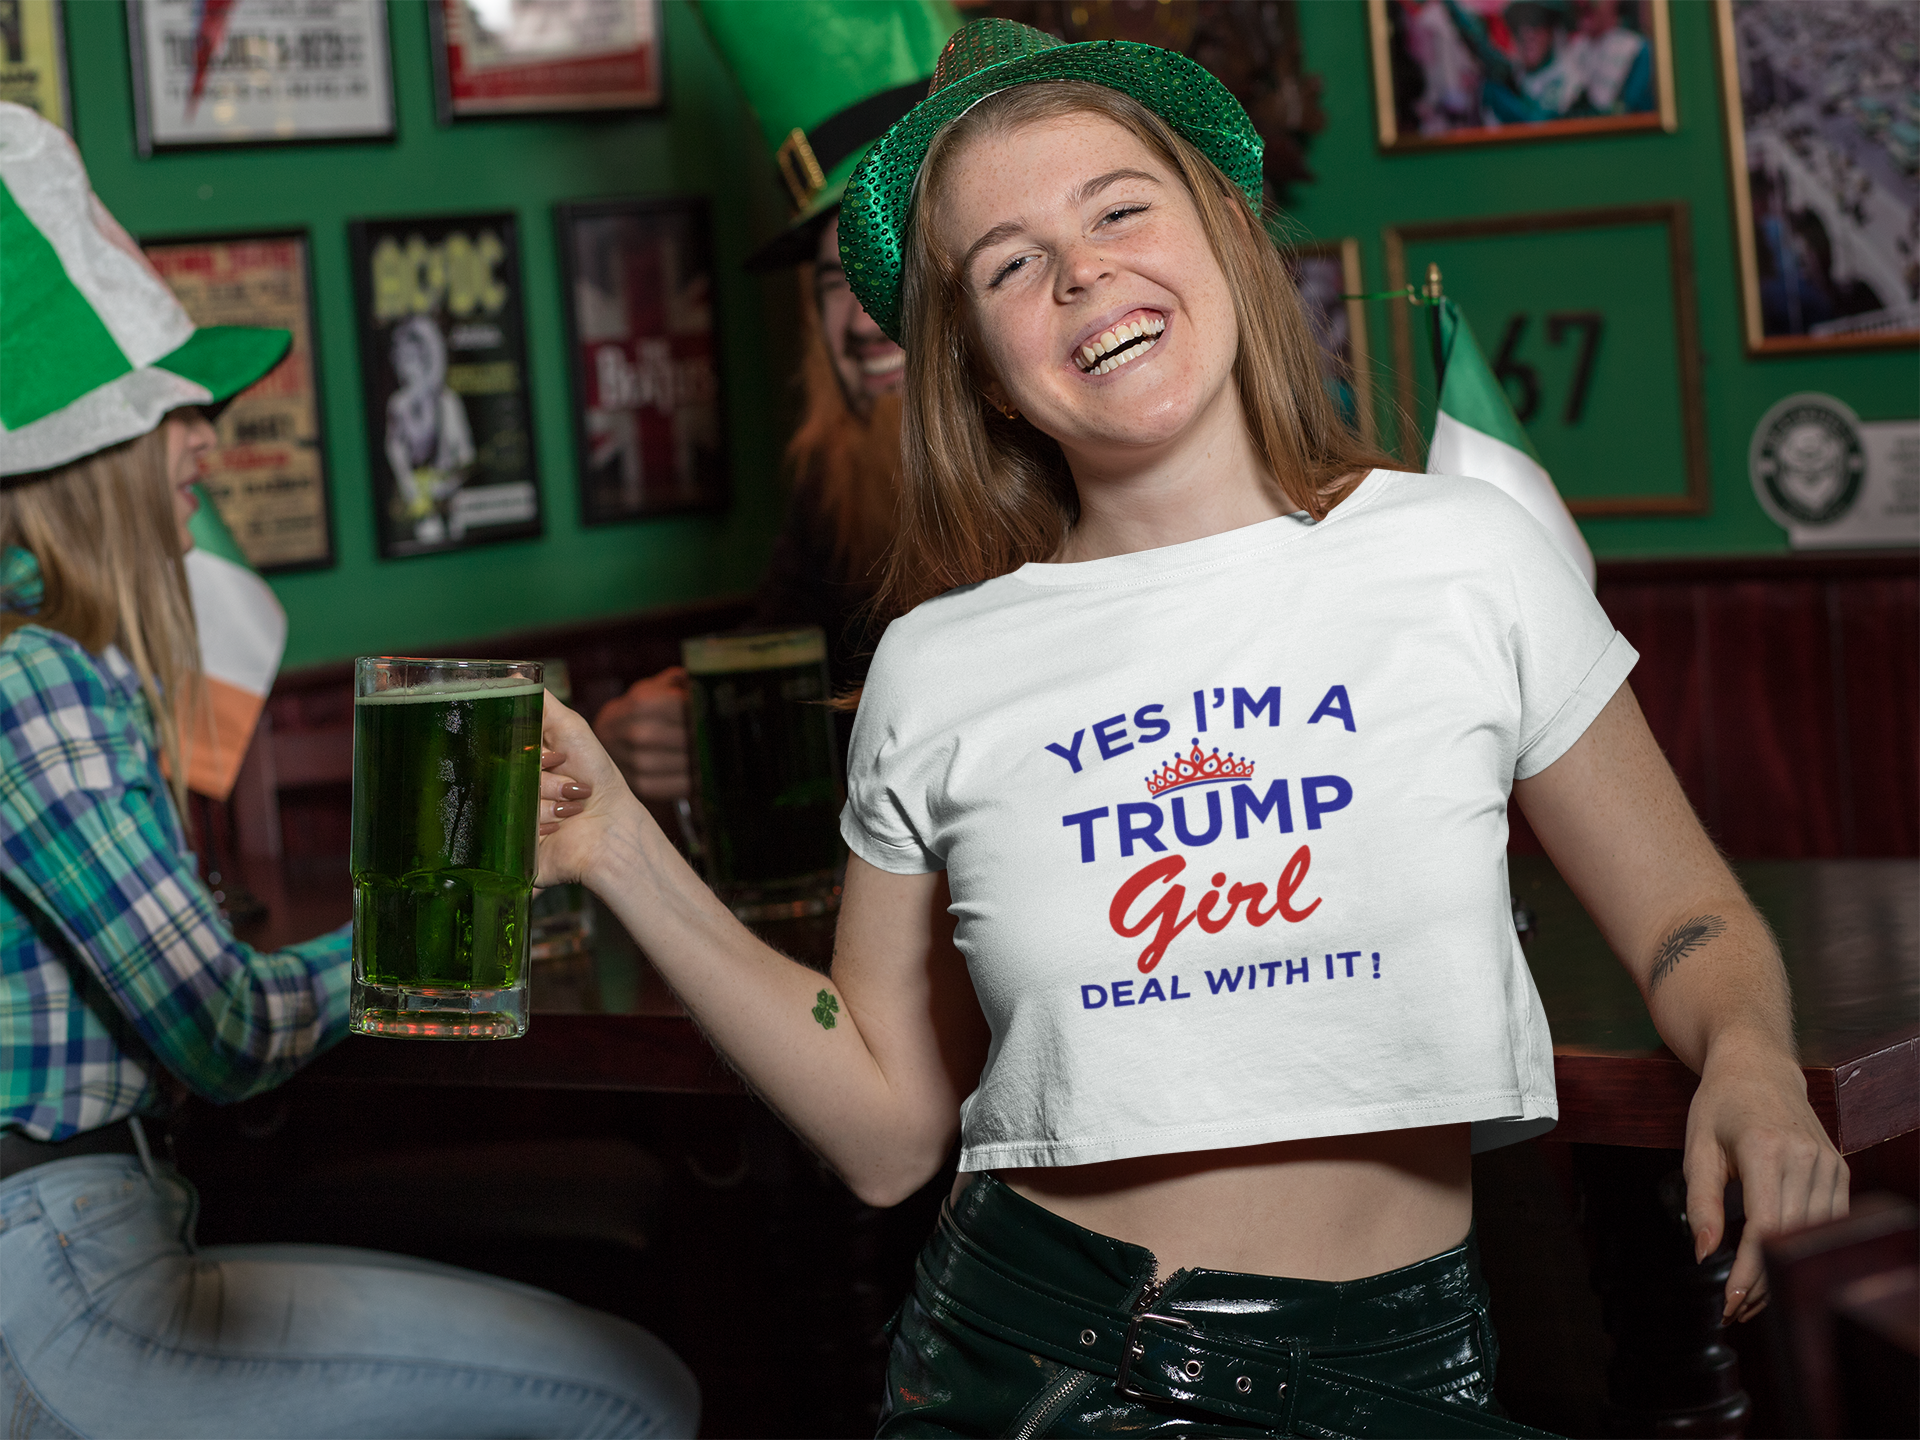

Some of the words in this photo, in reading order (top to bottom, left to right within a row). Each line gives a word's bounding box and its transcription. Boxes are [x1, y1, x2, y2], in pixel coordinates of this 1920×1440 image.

[1498, 310, 1604, 426] 67
[1044, 703, 1171, 774] YES
[1193, 685, 1282, 733] I'M
[1306, 684, 1357, 733] A
[1062, 774, 1354, 863] TRUMP
[1108, 844, 1323, 975] Girl
[1080, 975, 1191, 1010] DEAL
[1204, 956, 1310, 996] WITH
